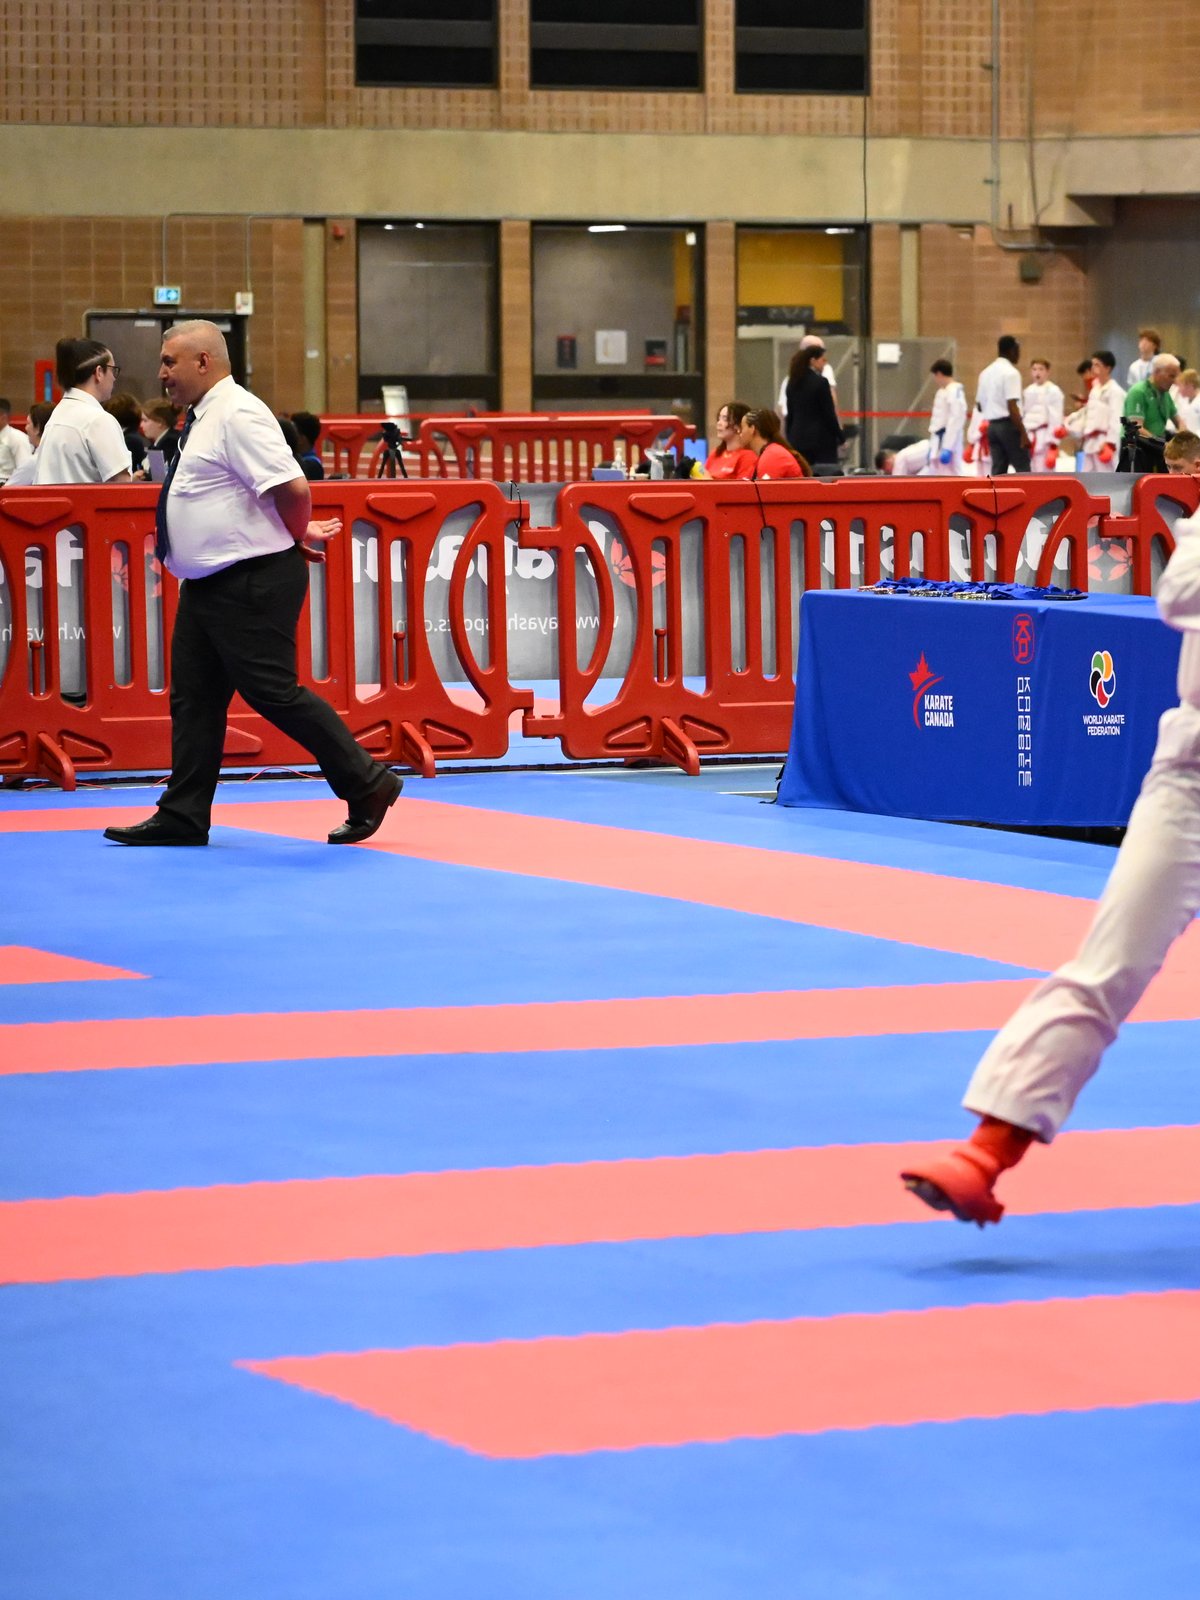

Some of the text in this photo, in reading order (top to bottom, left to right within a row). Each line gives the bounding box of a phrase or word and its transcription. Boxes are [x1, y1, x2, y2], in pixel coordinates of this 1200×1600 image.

[924, 694, 953, 711] KARATE
[924, 711, 954, 727] CANADA
[1083, 714, 1125, 725] WORLD KARATE
[1087, 726, 1120, 736] FEDERATION
